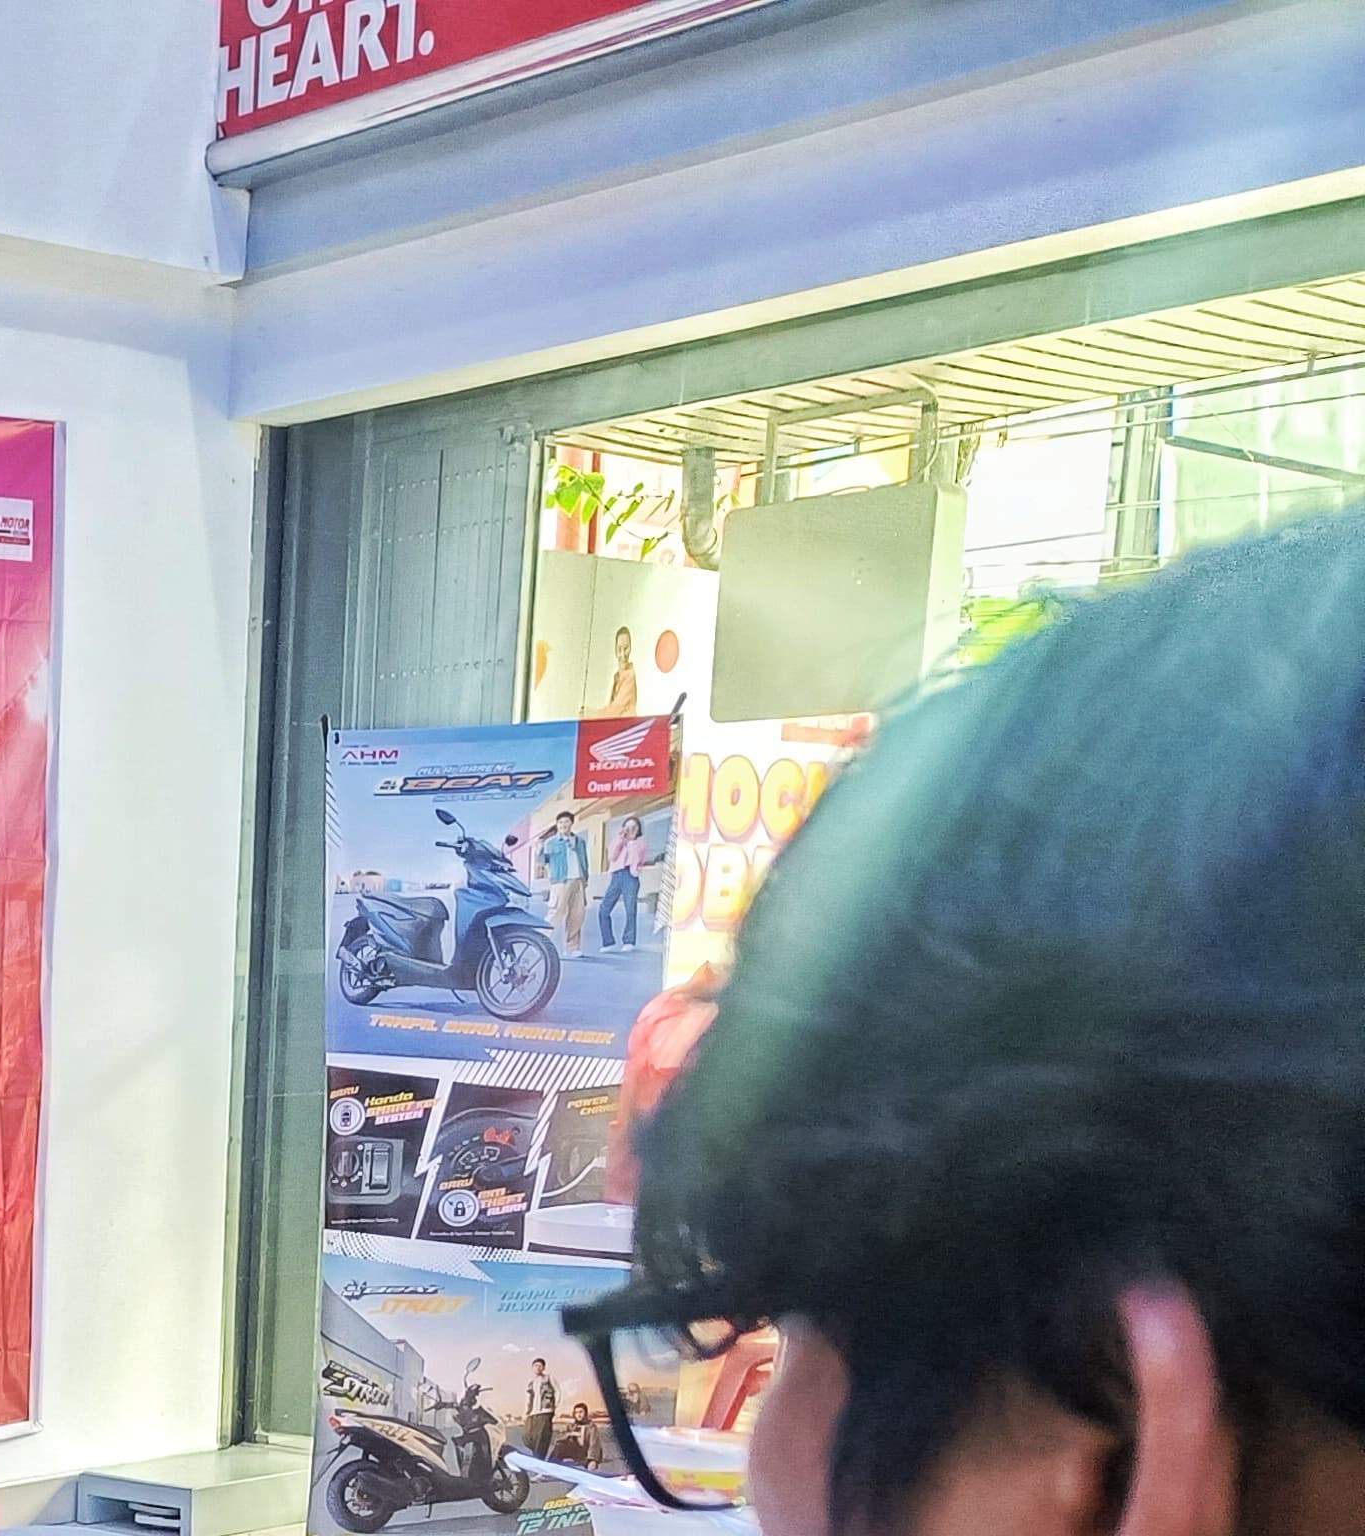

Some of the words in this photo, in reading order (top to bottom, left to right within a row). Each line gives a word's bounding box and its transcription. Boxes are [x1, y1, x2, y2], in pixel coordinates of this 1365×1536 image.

[0, 516, 31, 530] MOTOR
[588, 757, 656, 771] HONDA
[587, 780, 610, 793] One
[365, 1091, 414, 1107] Honda
